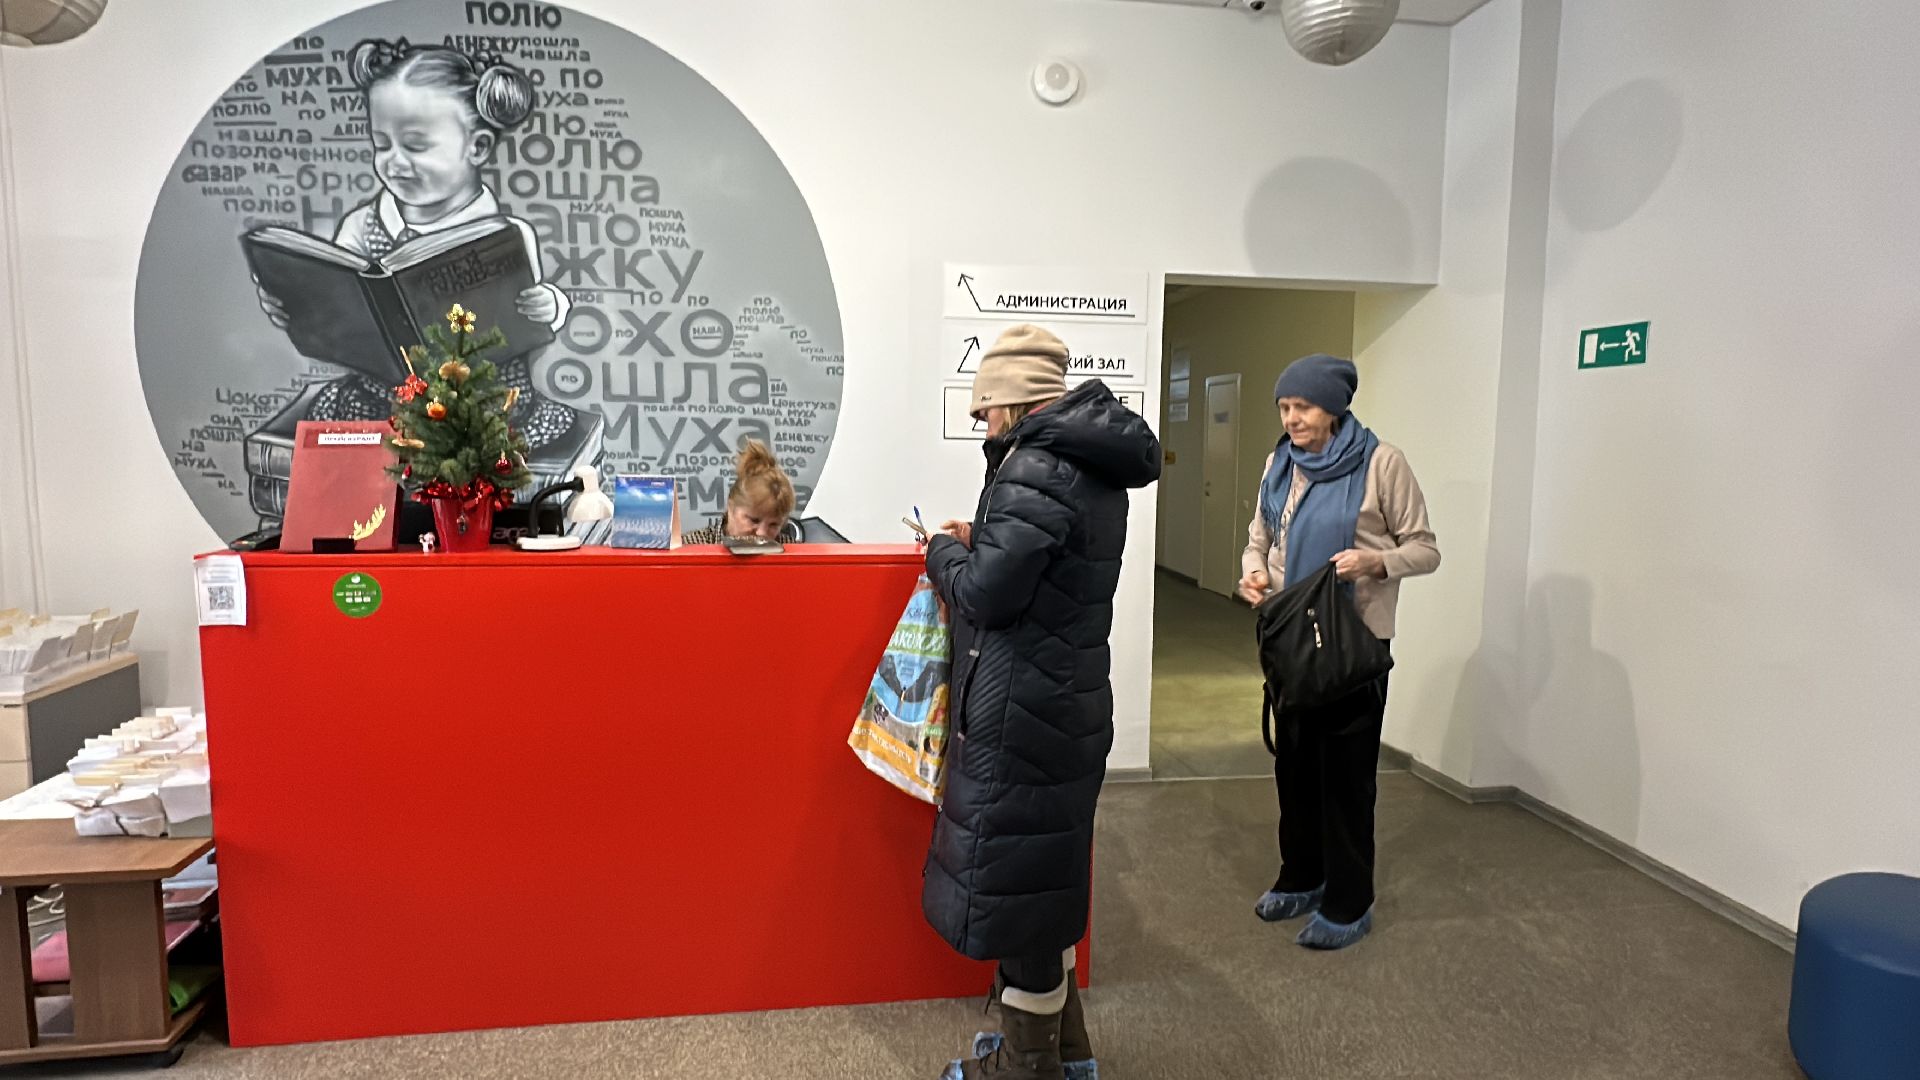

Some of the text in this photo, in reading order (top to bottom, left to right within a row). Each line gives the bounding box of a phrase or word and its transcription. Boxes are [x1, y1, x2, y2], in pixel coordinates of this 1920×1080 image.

[265, 66, 343, 88] МУХА
[996, 294, 1127, 311] АДМИНИСТРАЦИЯ
[1097, 357, 1125, 370] ЗАЛ
